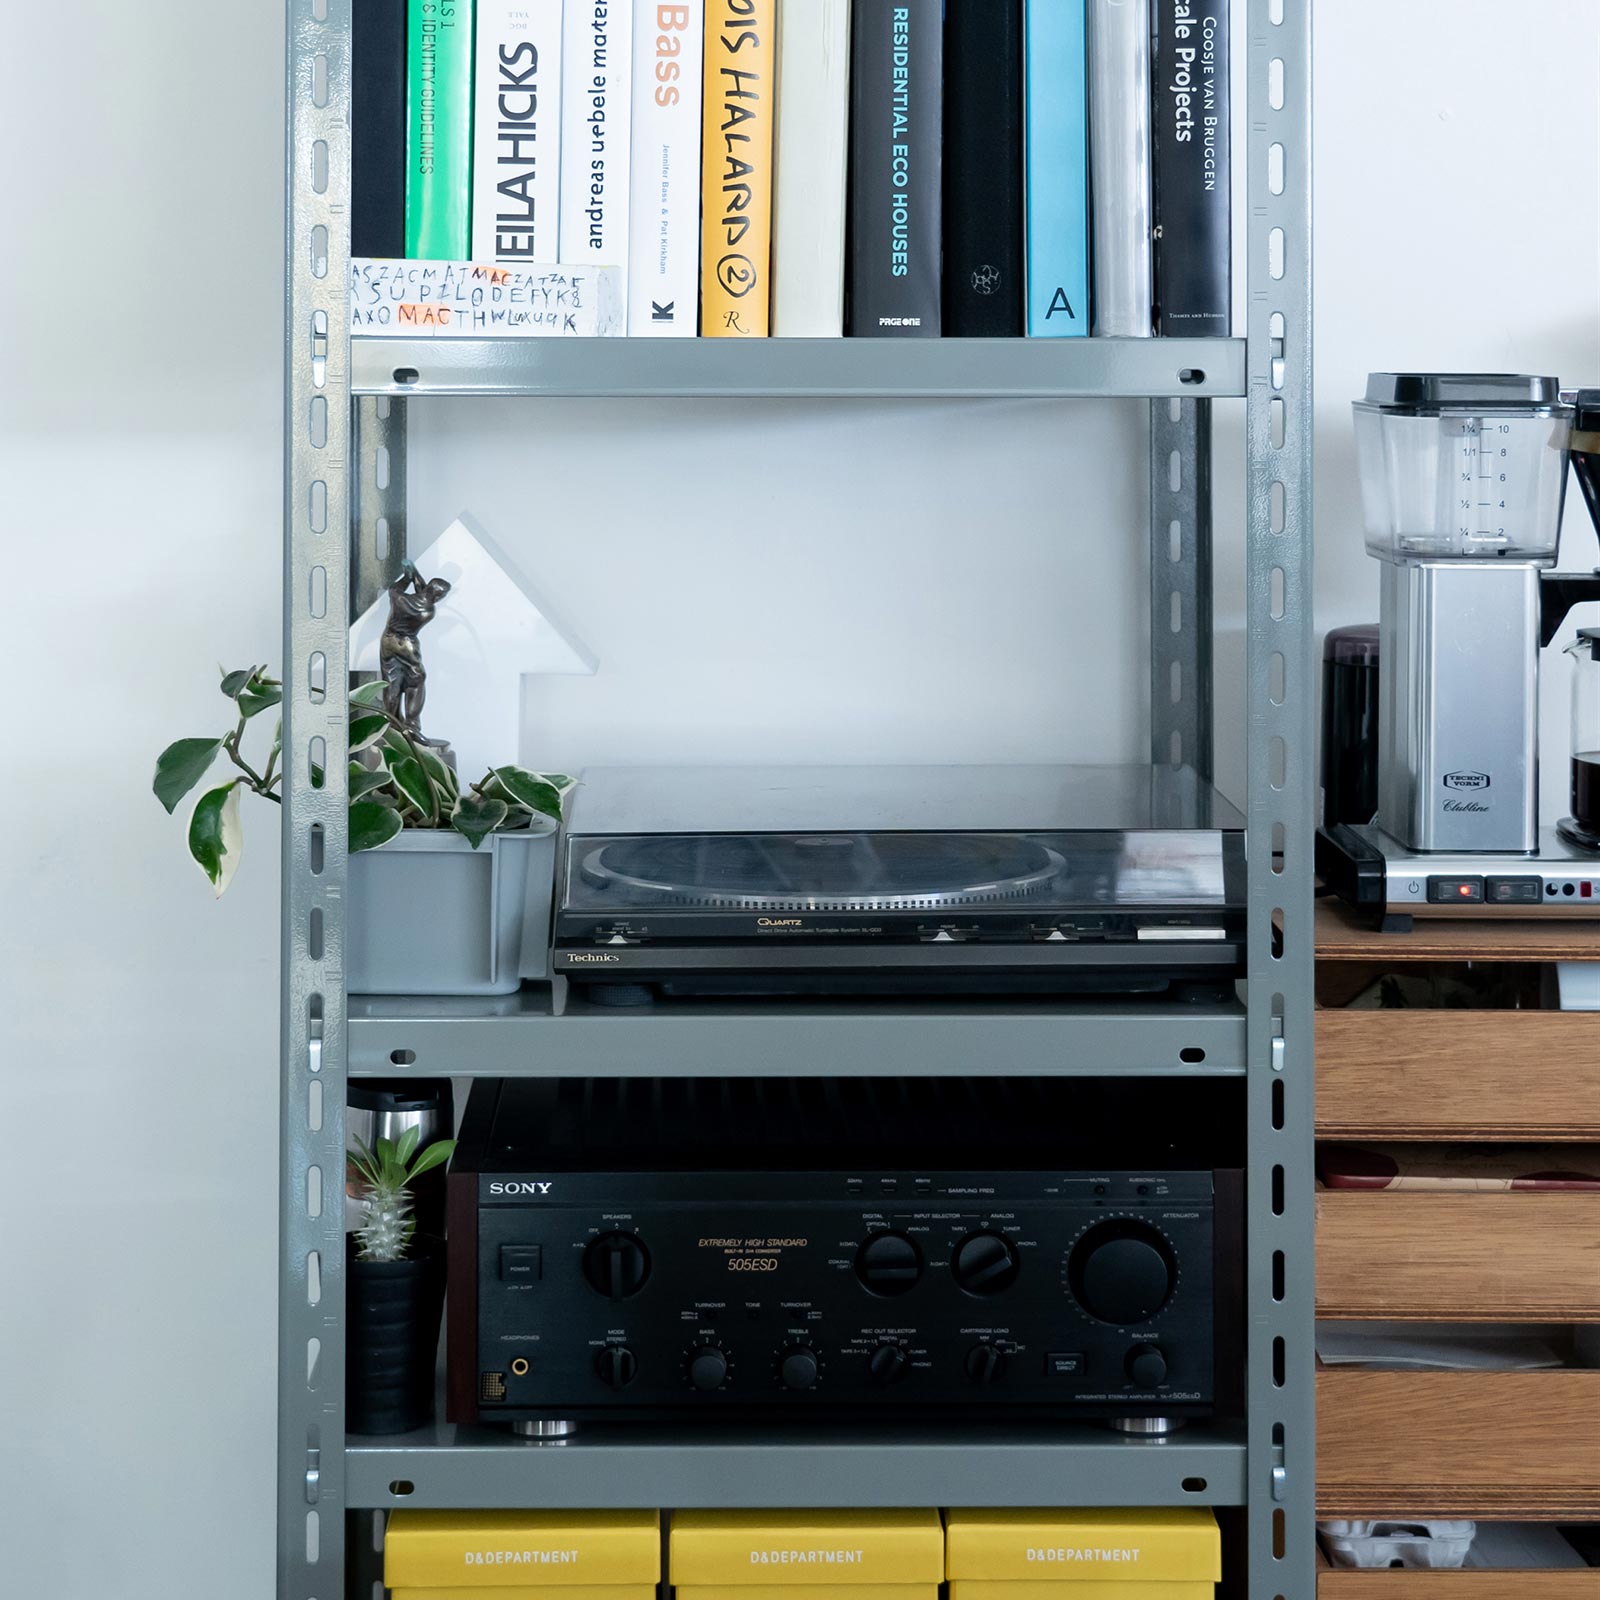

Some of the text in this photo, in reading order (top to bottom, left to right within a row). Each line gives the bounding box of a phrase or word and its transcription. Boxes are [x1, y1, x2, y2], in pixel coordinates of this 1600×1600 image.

[655, 4, 690, 107] Bass
[419, 4, 437, 174] & IDENTITY GUIDELINES
[1169, 47, 1197, 142] Projects
[587, 75, 606, 152] uebele
[891, 8, 909, 277] RESIDENTIAL ECO HOUSES
[496, 42, 538, 263] EILA HICKS
[720, 67, 760, 246] HALARD
[1202, 116, 1218, 191] BRUGGEN
[586, 159, 605, 249] andreas
[659, 143, 671, 275] Jennifer Bass & Pat Kirkham
[1045, 287, 1076, 320] A
[723, 311, 750, 334] R
[1499, 425, 1510, 434] 10
[1464, 448, 1507, 457] 1/1 8
[1500, 473, 1506, 482] 6
[1499, 500, 1505, 508] 4
[1498, 528, 1505, 537] 2
[1442, 798, 1490, 812] Clubline
[567, 952, 620, 962] Technics
[490, 1182, 552, 1194] SONY
[698, 1238, 808, 1247] EXTREMELY HIGH STANDARD
[728, 1258, 778, 1271] 505ESD
[465, 1549, 579, 1564] D&DEPARTMENT
[750, 1549, 864, 1564] D&DEPARTMENT
[1027, 1548, 1140, 1562] D&DEPARTMENT
